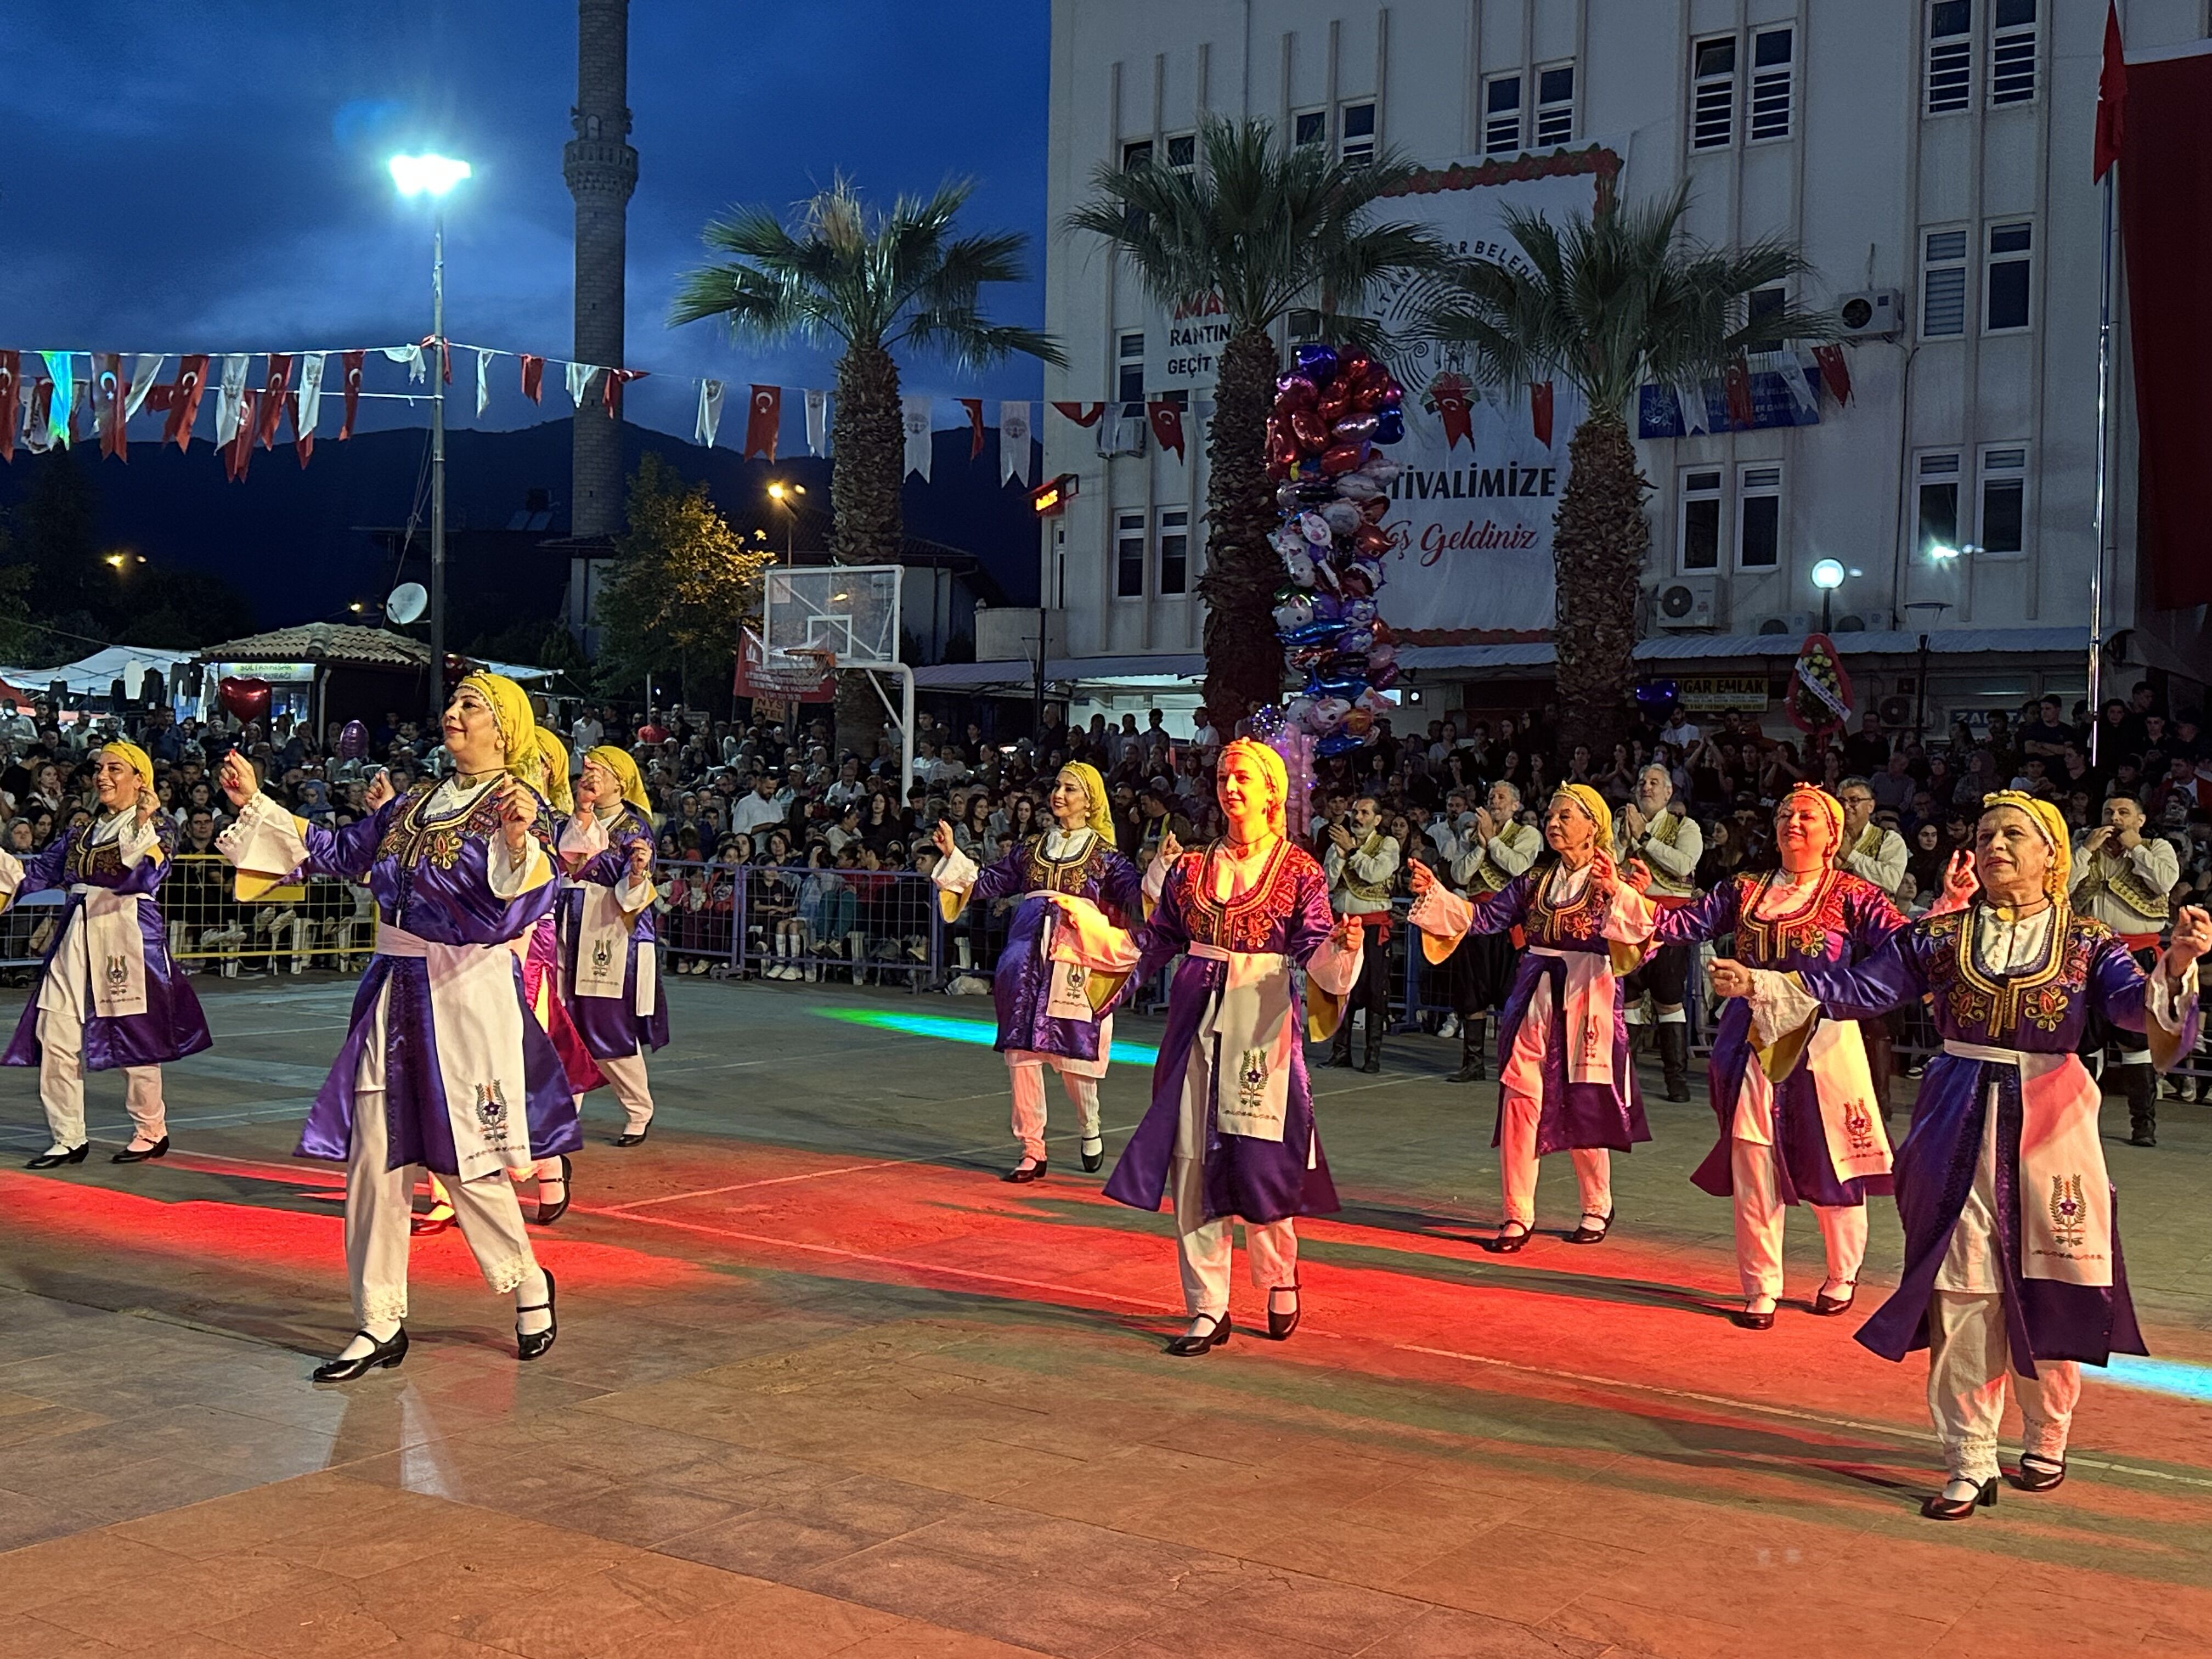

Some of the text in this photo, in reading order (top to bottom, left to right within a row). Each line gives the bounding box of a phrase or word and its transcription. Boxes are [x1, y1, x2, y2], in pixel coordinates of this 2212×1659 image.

[1170, 324, 1232, 347] RANTIN
[1168, 353, 1211, 379] GEÇİT
[1384, 461, 1556, 500] TİVALİMİZE
[1420, 520, 1540, 567] Geldiniz
[1717, 680, 1764, 693] EMLAK
